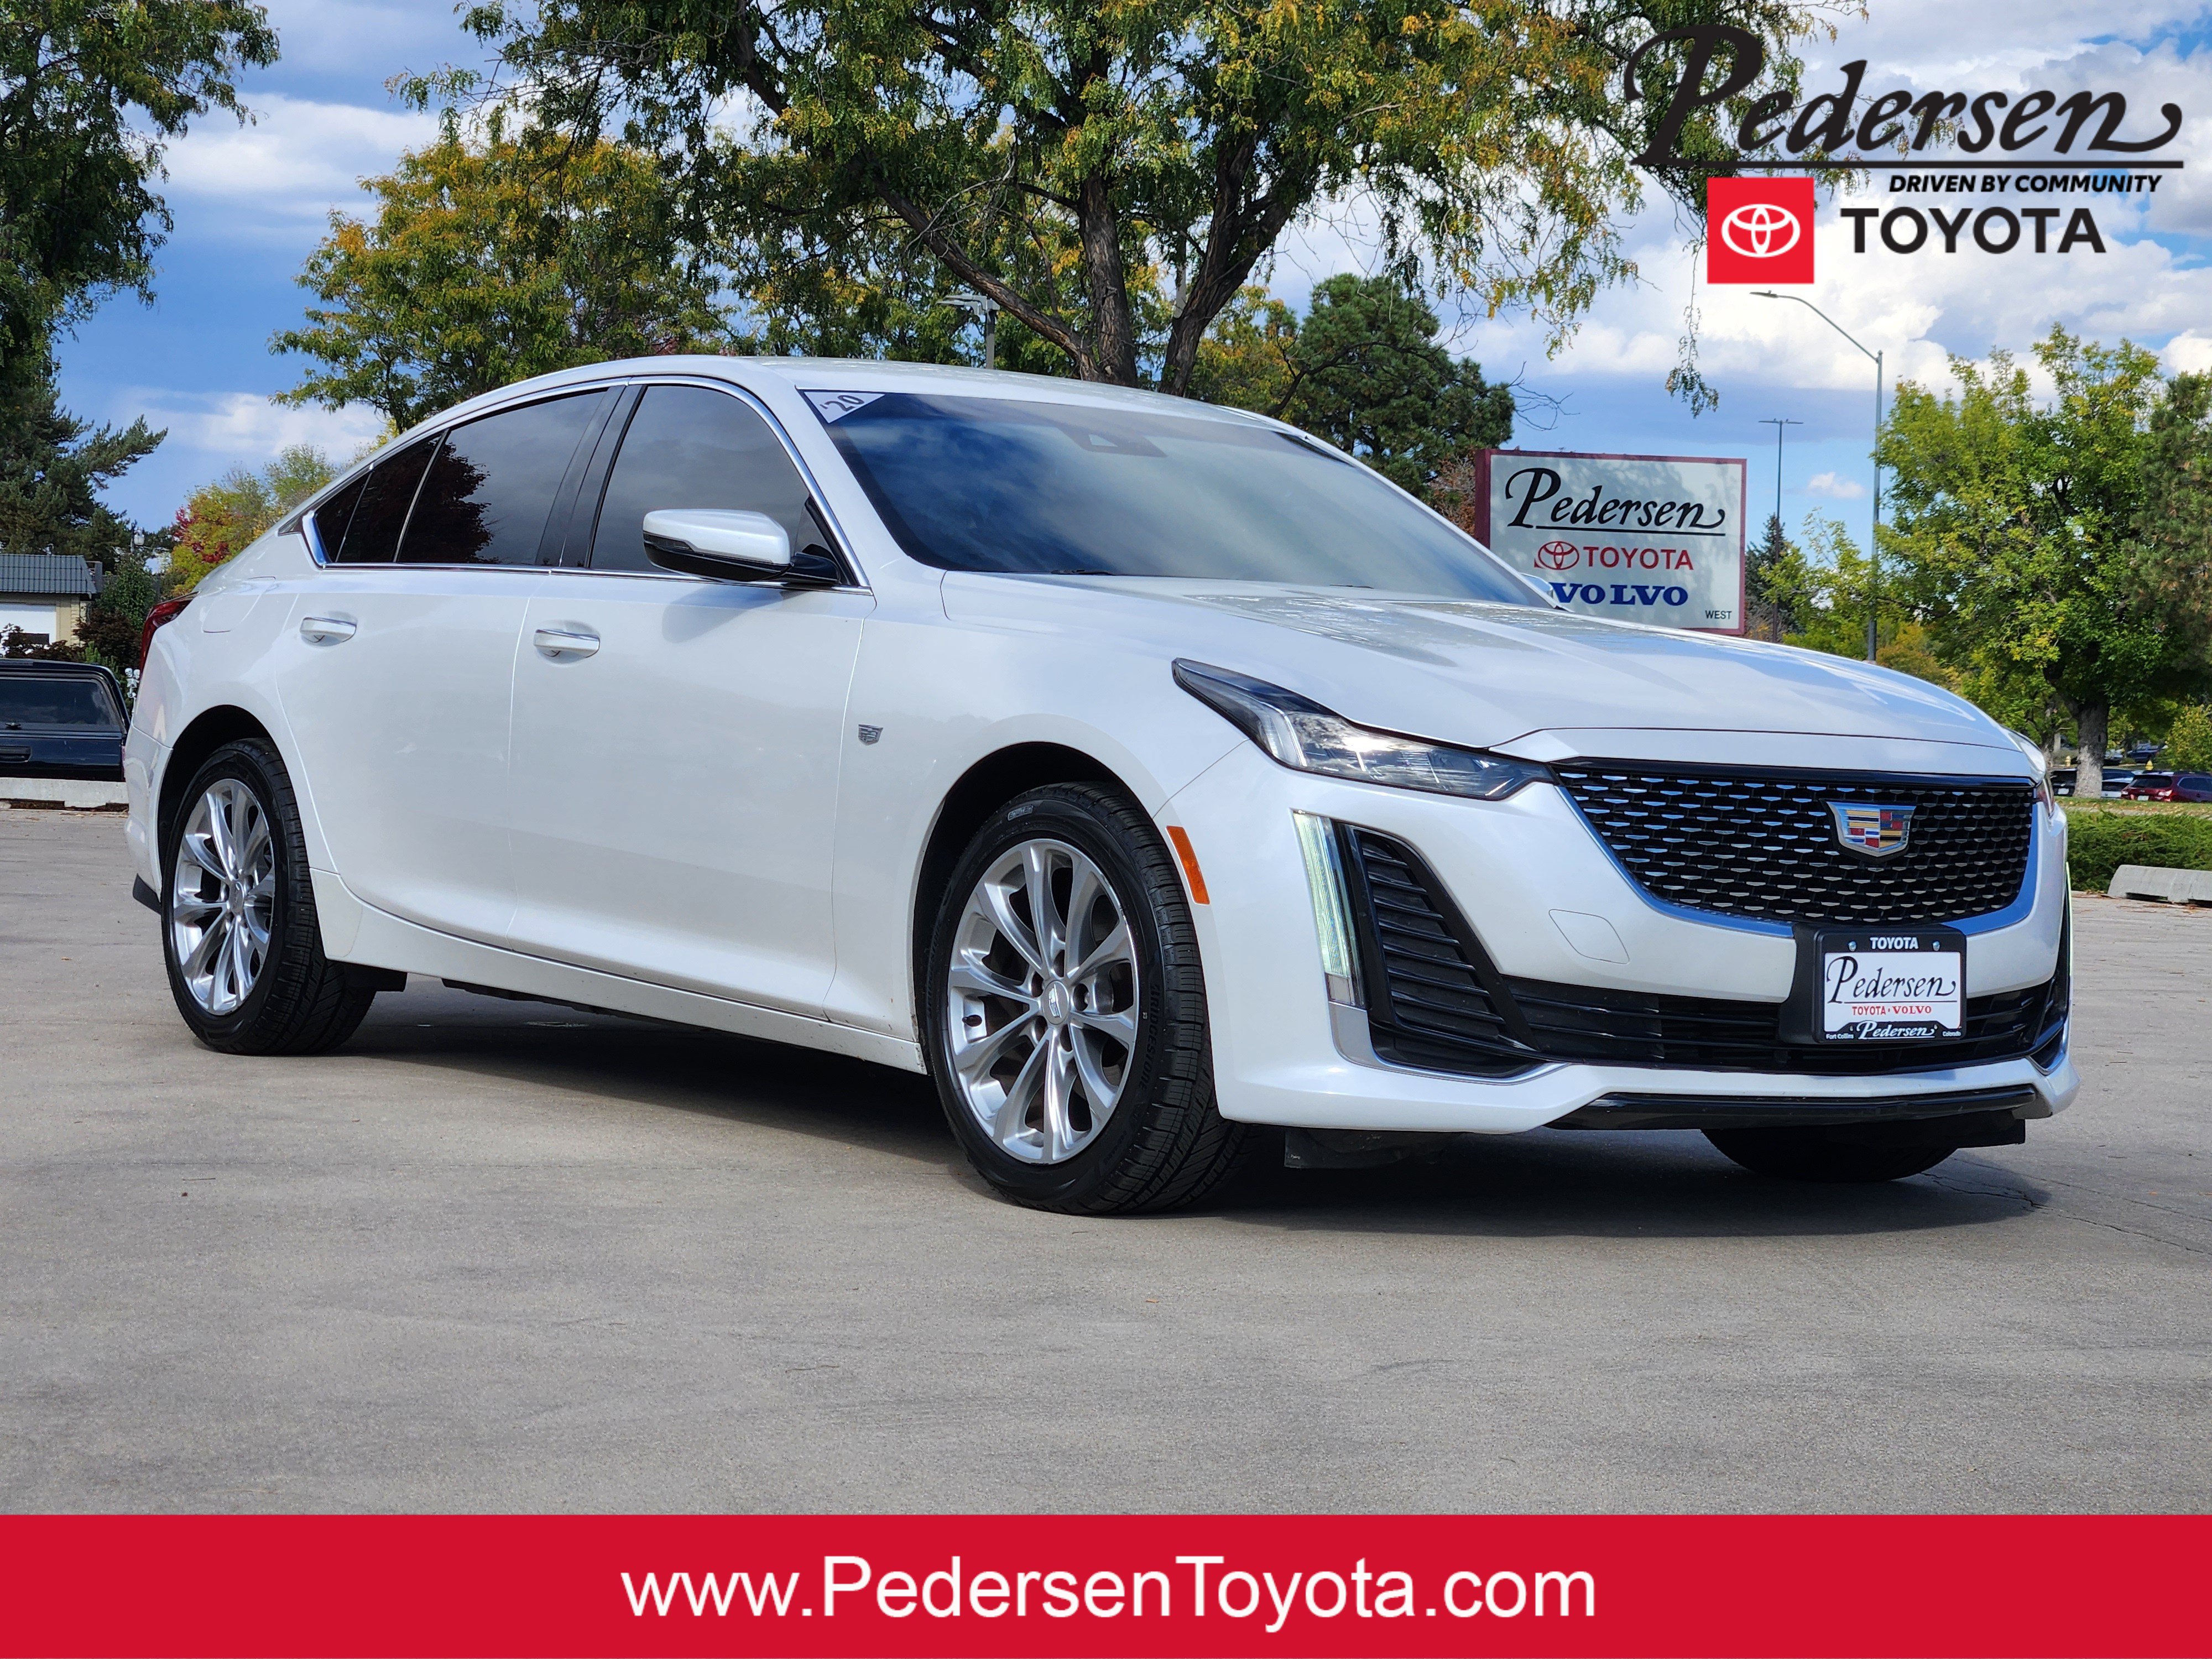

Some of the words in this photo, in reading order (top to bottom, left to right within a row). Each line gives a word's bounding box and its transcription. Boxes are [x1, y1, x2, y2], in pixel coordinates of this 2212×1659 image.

[1505, 467, 1726, 529] Pedersen
[1583, 546, 1694, 570] TOYOTA
[1549, 582, 1688, 606] VOLVO
[1705, 610, 1732, 619] WEST
[1870, 937, 1919, 950] TOYOTA
[1826, 956, 1957, 1004] Pedersen
[1853, 1005, 1886, 1015] TOYOTA
[1892, 1005, 1932, 1014] VOLVO
[1856, 1020, 1935, 1039] Pedersen
